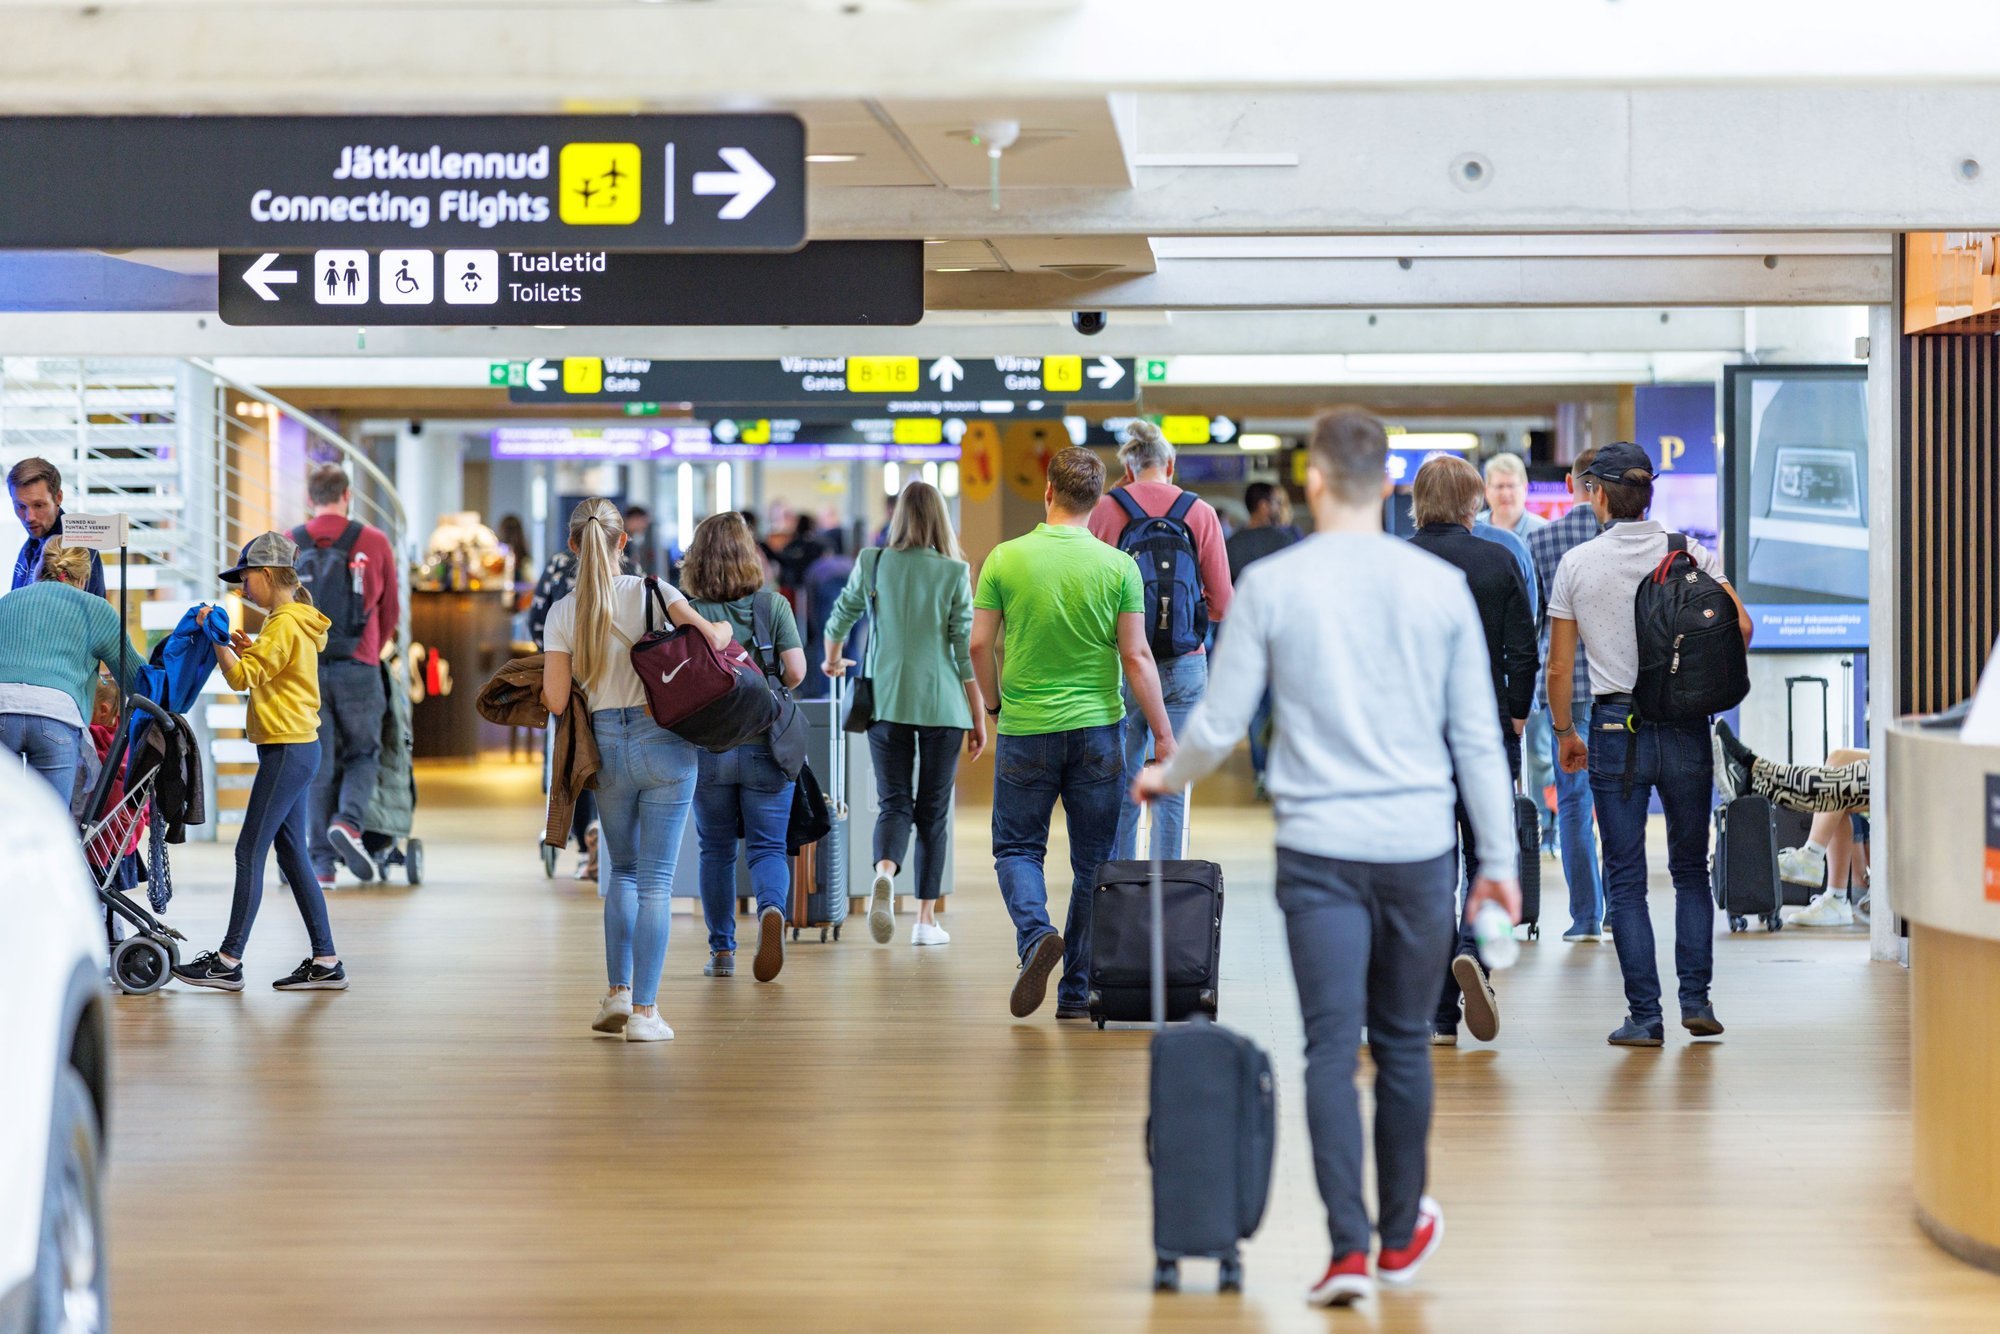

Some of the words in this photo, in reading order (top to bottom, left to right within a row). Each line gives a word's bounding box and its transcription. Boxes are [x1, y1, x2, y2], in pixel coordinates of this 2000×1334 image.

[333, 145, 550, 180] Jätkulennud
[250, 189, 431, 228] Connecting
[439, 189, 550, 228] Flights
[508, 252, 606, 272] Tualetid
[508, 283, 582, 302] Toilets
[579, 365, 589, 383] 7
[1057, 364, 1070, 381] 6
[604, 375, 641, 392] Gate
[802, 374, 846, 391] Gates
[1004, 374, 1041, 391] Gate
